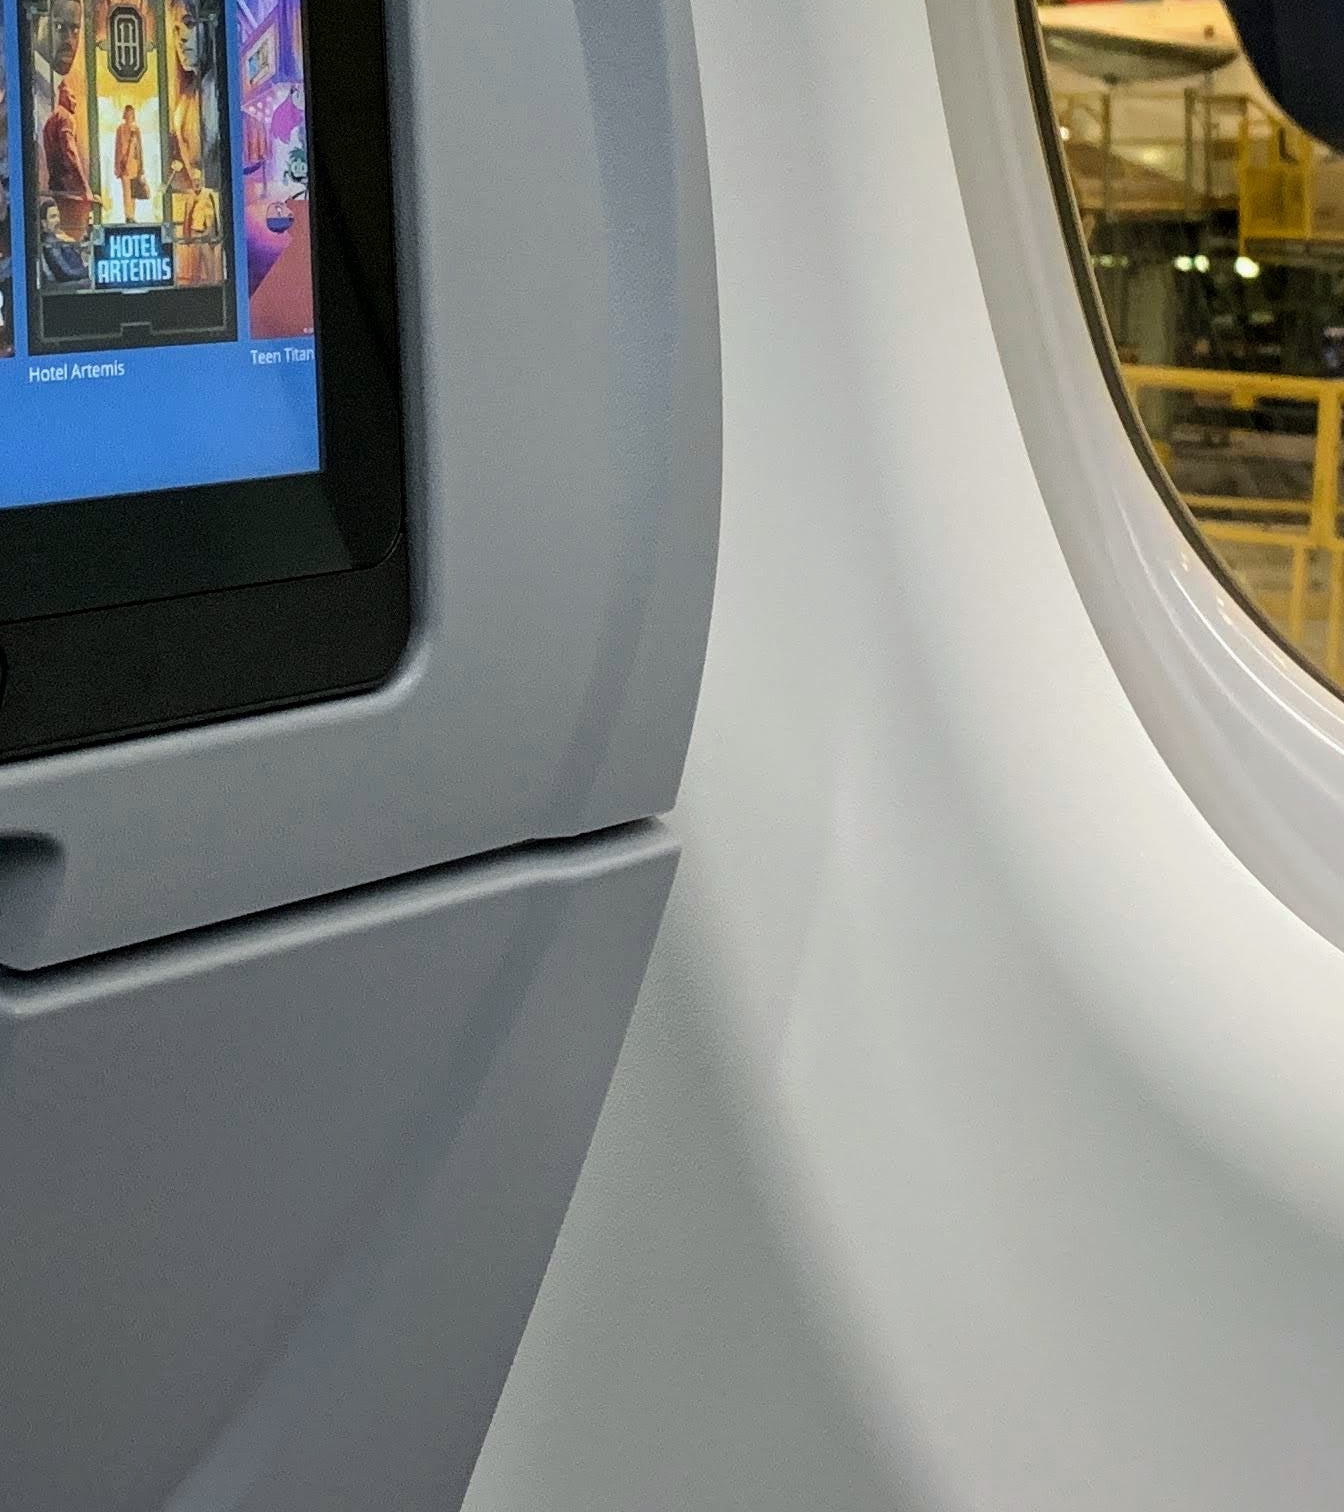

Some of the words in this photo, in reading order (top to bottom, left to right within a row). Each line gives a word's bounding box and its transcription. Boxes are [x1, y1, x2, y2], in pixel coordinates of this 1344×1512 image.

[109, 234, 158, 258] HOTEL
[98, 257, 172, 284] ARTEMIS
[249, 349, 282, 366] Teen
[29, 366, 68, 383] Hotel
[71, 360, 126, 380] Artemis
